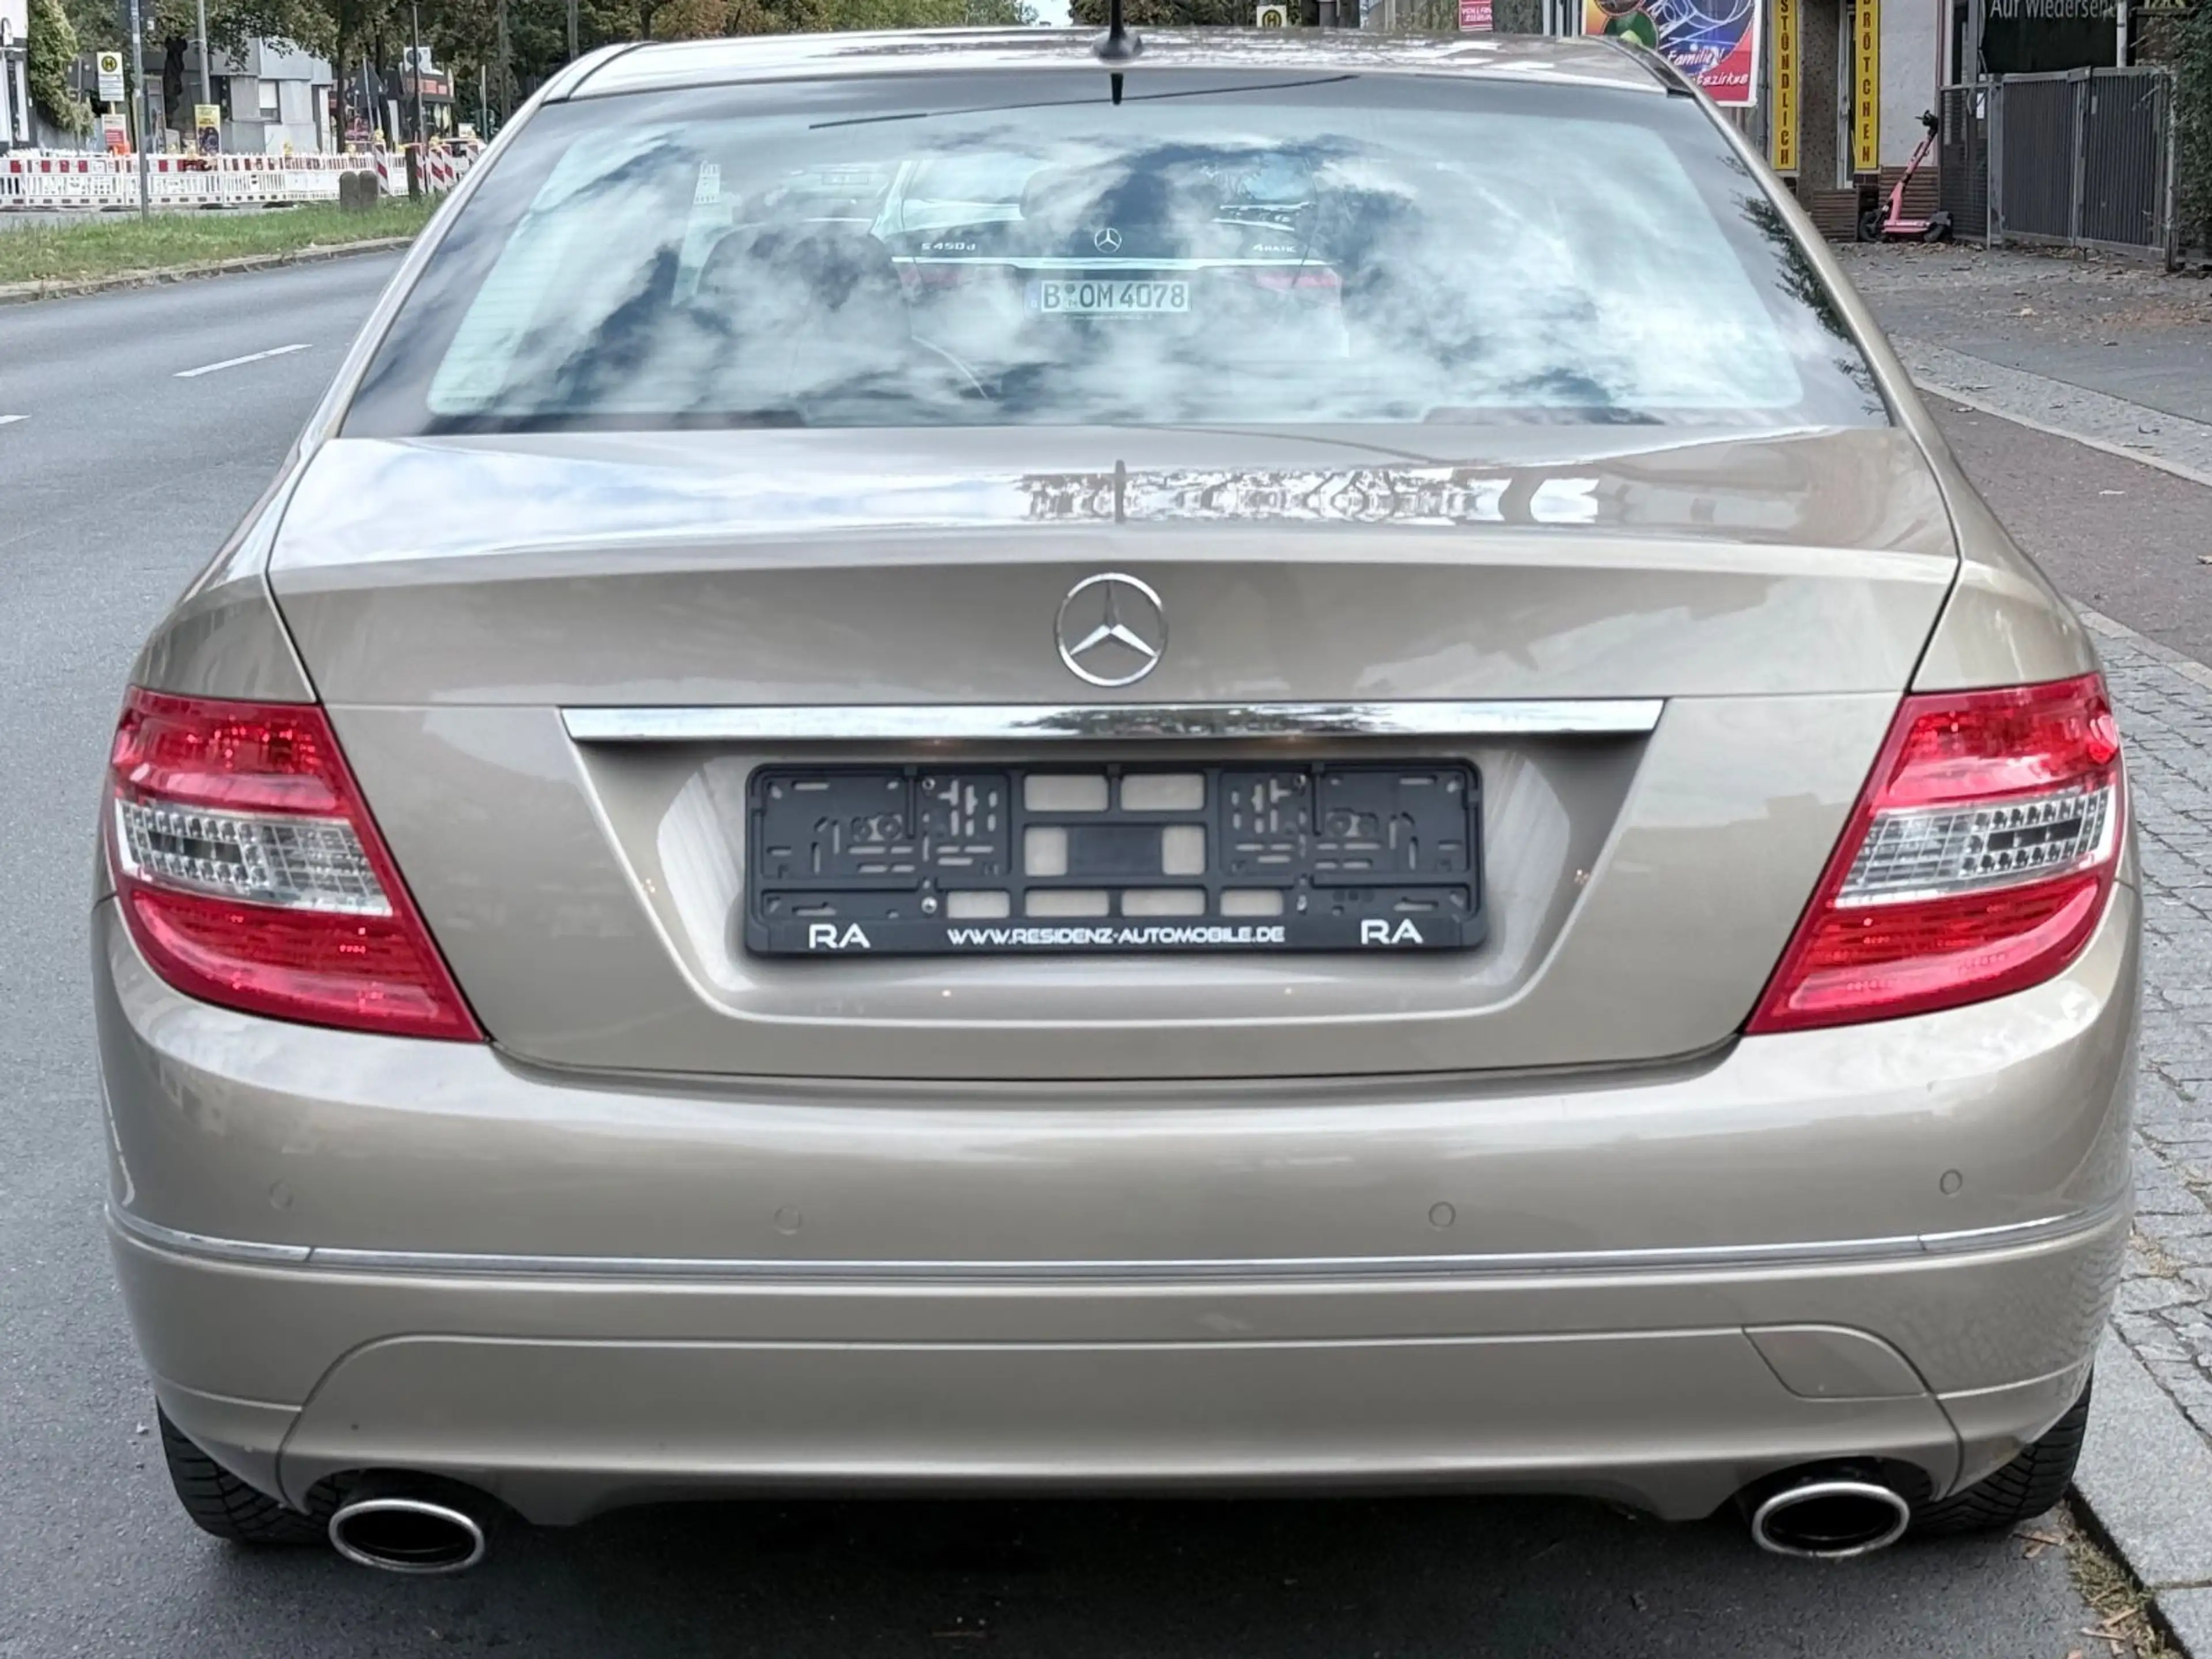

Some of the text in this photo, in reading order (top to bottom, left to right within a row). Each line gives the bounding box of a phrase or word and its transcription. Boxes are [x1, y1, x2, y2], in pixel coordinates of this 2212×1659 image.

[1862, 0, 1871, 162] RÖTCHEN
[809, 919, 1423, 949] RA WWW.RESIDENZ-AUTOMOBILE.DE RA
